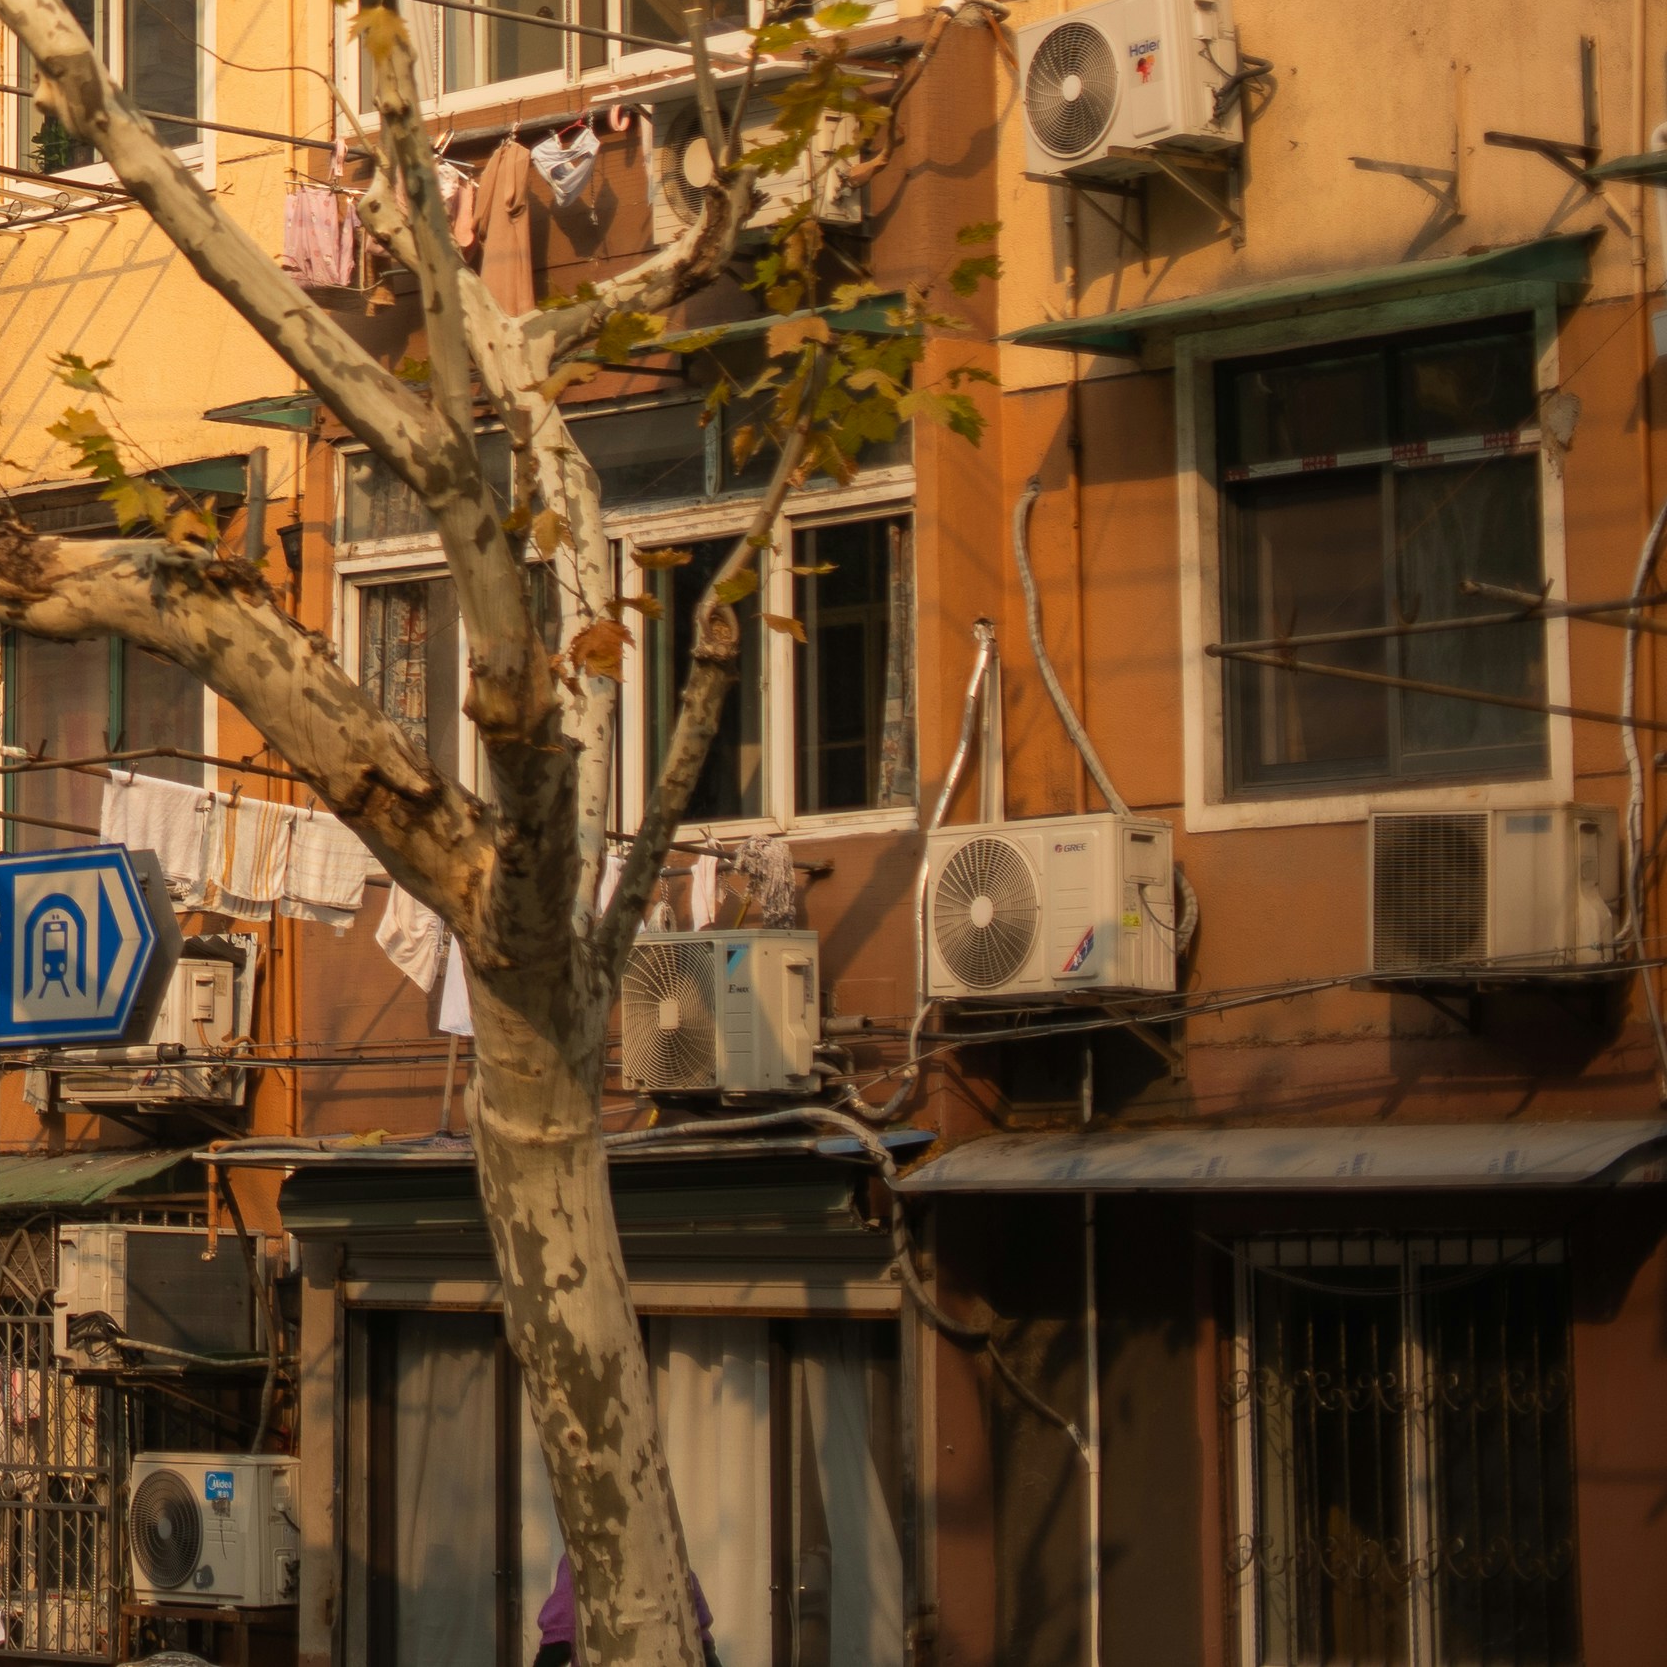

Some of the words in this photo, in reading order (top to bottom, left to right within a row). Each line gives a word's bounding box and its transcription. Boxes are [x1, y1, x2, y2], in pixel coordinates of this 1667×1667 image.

[1129, 39, 1160, 57] Haier
[1064, 843, 1087, 852] GREE
[212, 1479, 232, 1489] Midea
